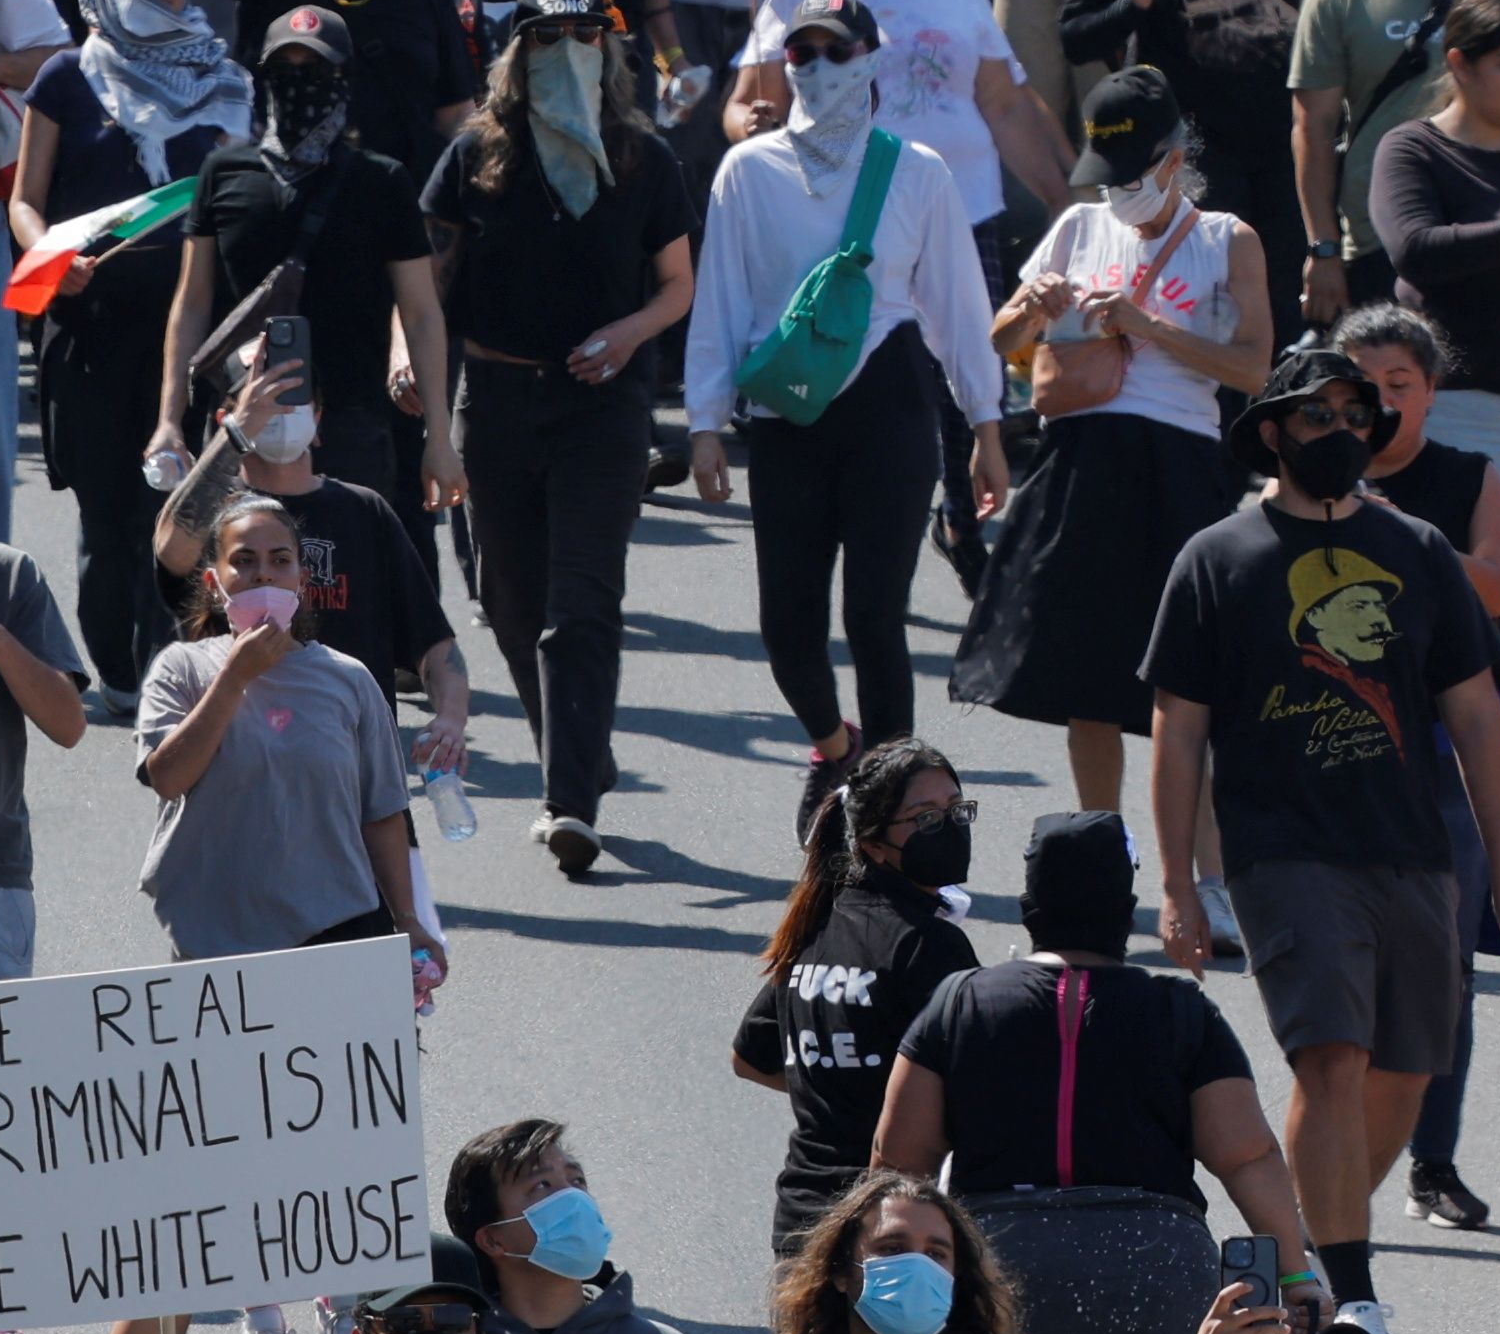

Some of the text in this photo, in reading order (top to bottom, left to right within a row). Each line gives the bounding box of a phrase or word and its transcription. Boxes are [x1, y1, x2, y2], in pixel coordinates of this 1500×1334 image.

[542, 0, 589, 16] SONG
[1259, 684, 1346, 723] Pancho
[1311, 709, 1382, 737] Villa
[91, 969, 275, 1046] REAL
[256, 1045, 325, 1140] IS
[342, 1039, 408, 1130] IN
[62, 1202, 235, 1304] WHITE
[239, 1173, 421, 1278] HOUSE
